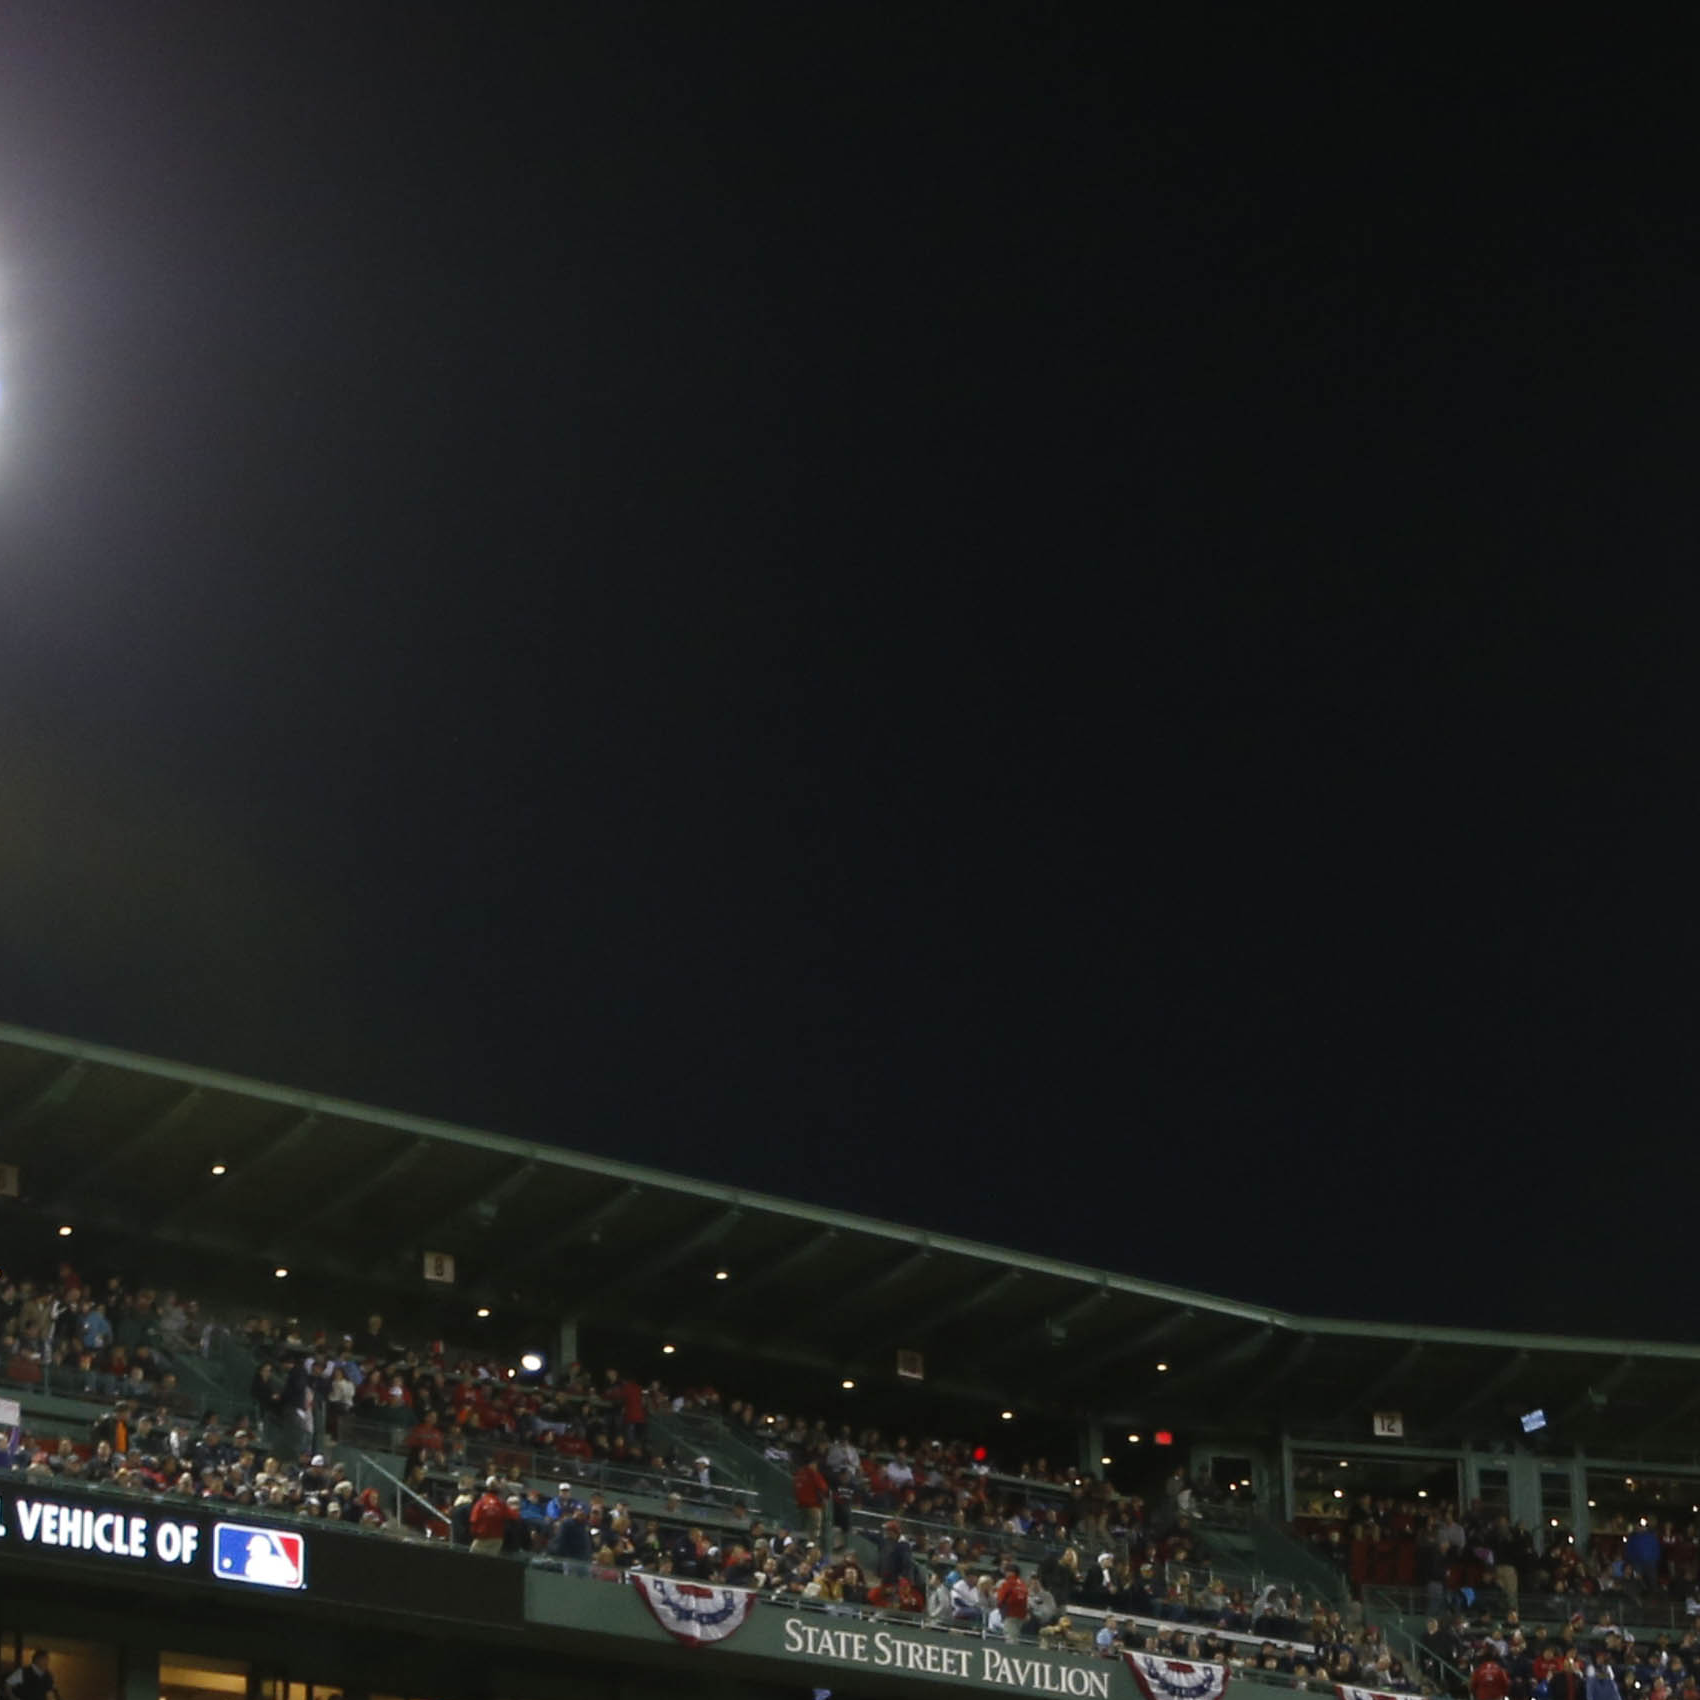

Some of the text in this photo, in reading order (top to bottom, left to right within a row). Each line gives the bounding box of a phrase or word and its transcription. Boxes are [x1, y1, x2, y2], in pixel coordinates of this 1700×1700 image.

[1380, 1415, 1397, 1433] 12
[16, 1499, 147, 1558] VEHICLE
[156, 1521, 199, 1563] OF
[783, 1618, 1109, 1700] STATE STREET PAVILION
